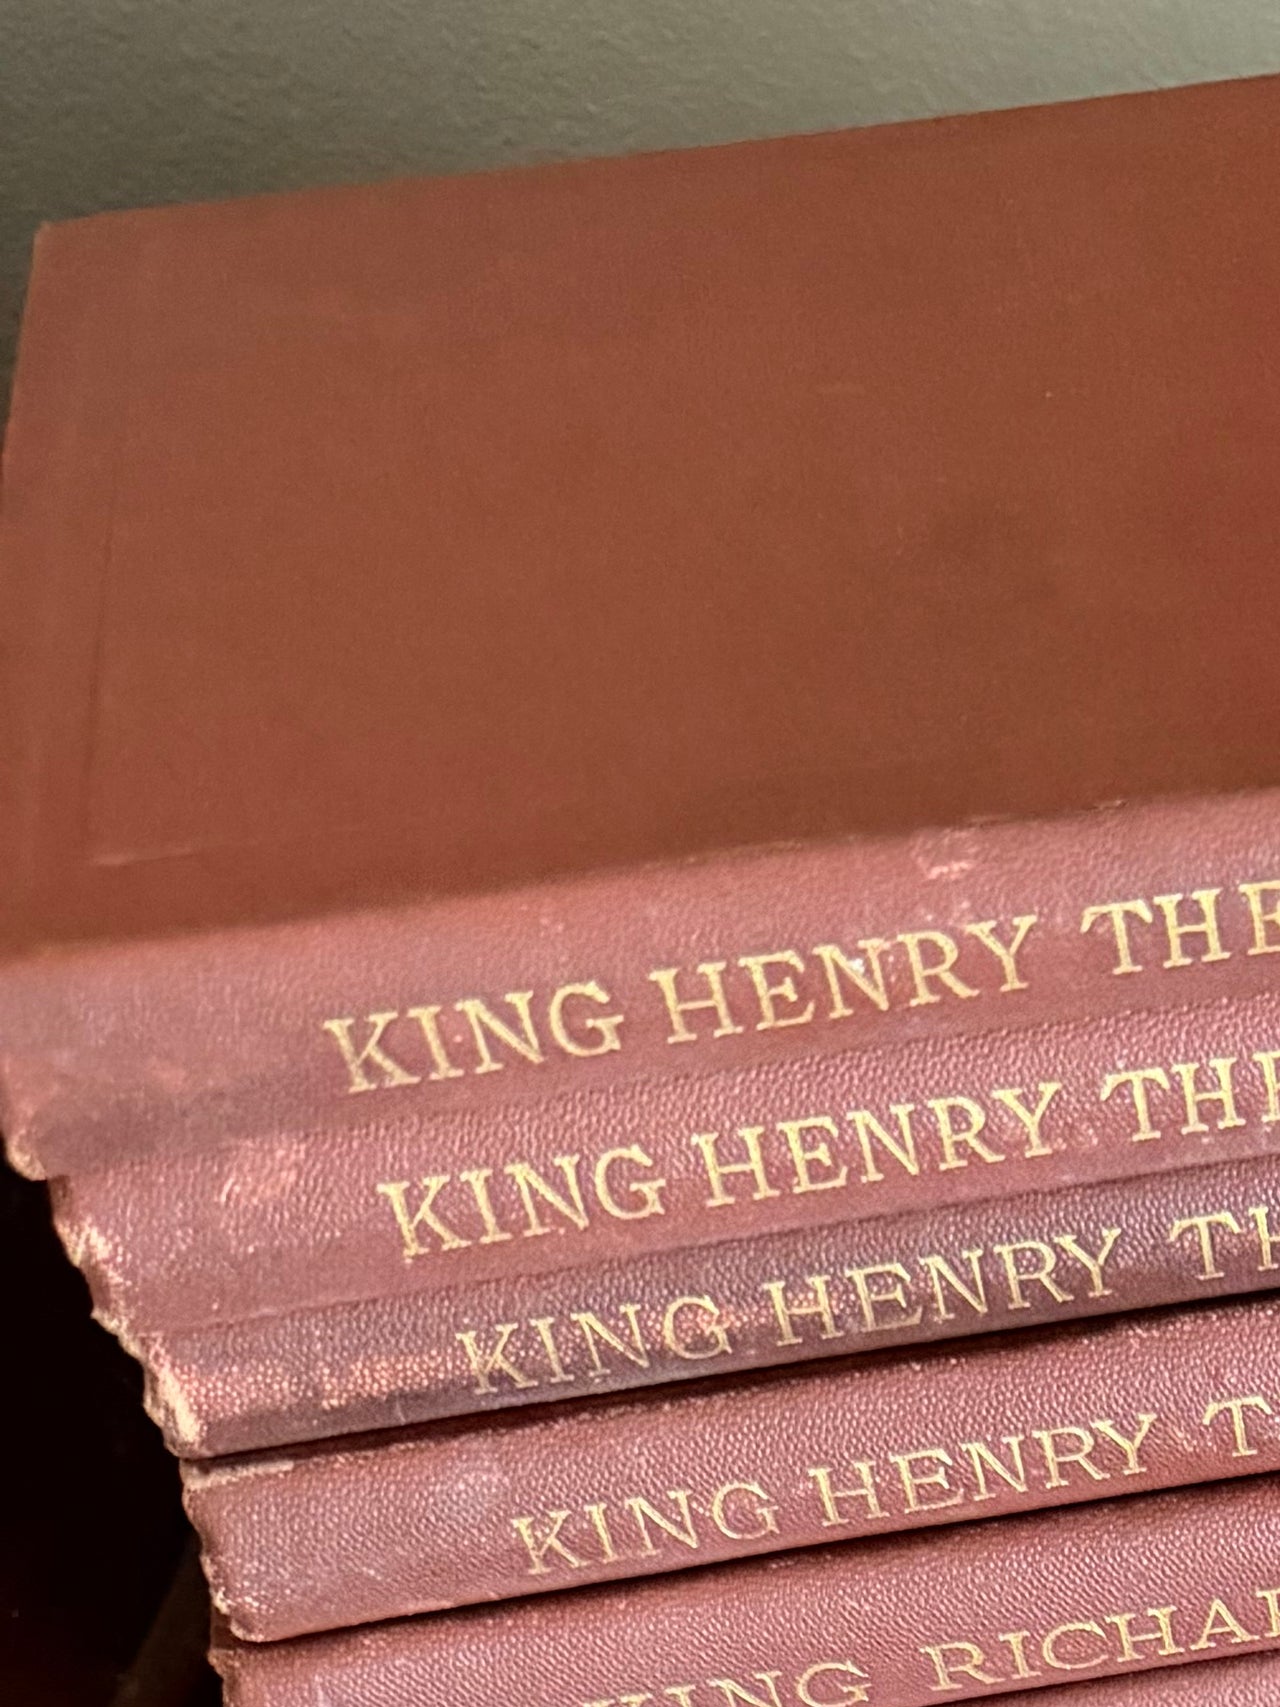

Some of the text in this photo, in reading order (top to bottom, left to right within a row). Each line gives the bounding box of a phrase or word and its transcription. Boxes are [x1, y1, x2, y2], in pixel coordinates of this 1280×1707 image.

[324, 981, 625, 1093] KING
[650, 914, 1038, 1044] HENRY
[377, 1144, 666, 1262] KING
[691, 1081, 1064, 1206] HENRY
[455, 1294, 733, 1395] KING
[762, 1227, 1123, 1346] HENRY
[513, 1480, 781, 1576] KING
[808, 1412, 1159, 1526] HENRY
